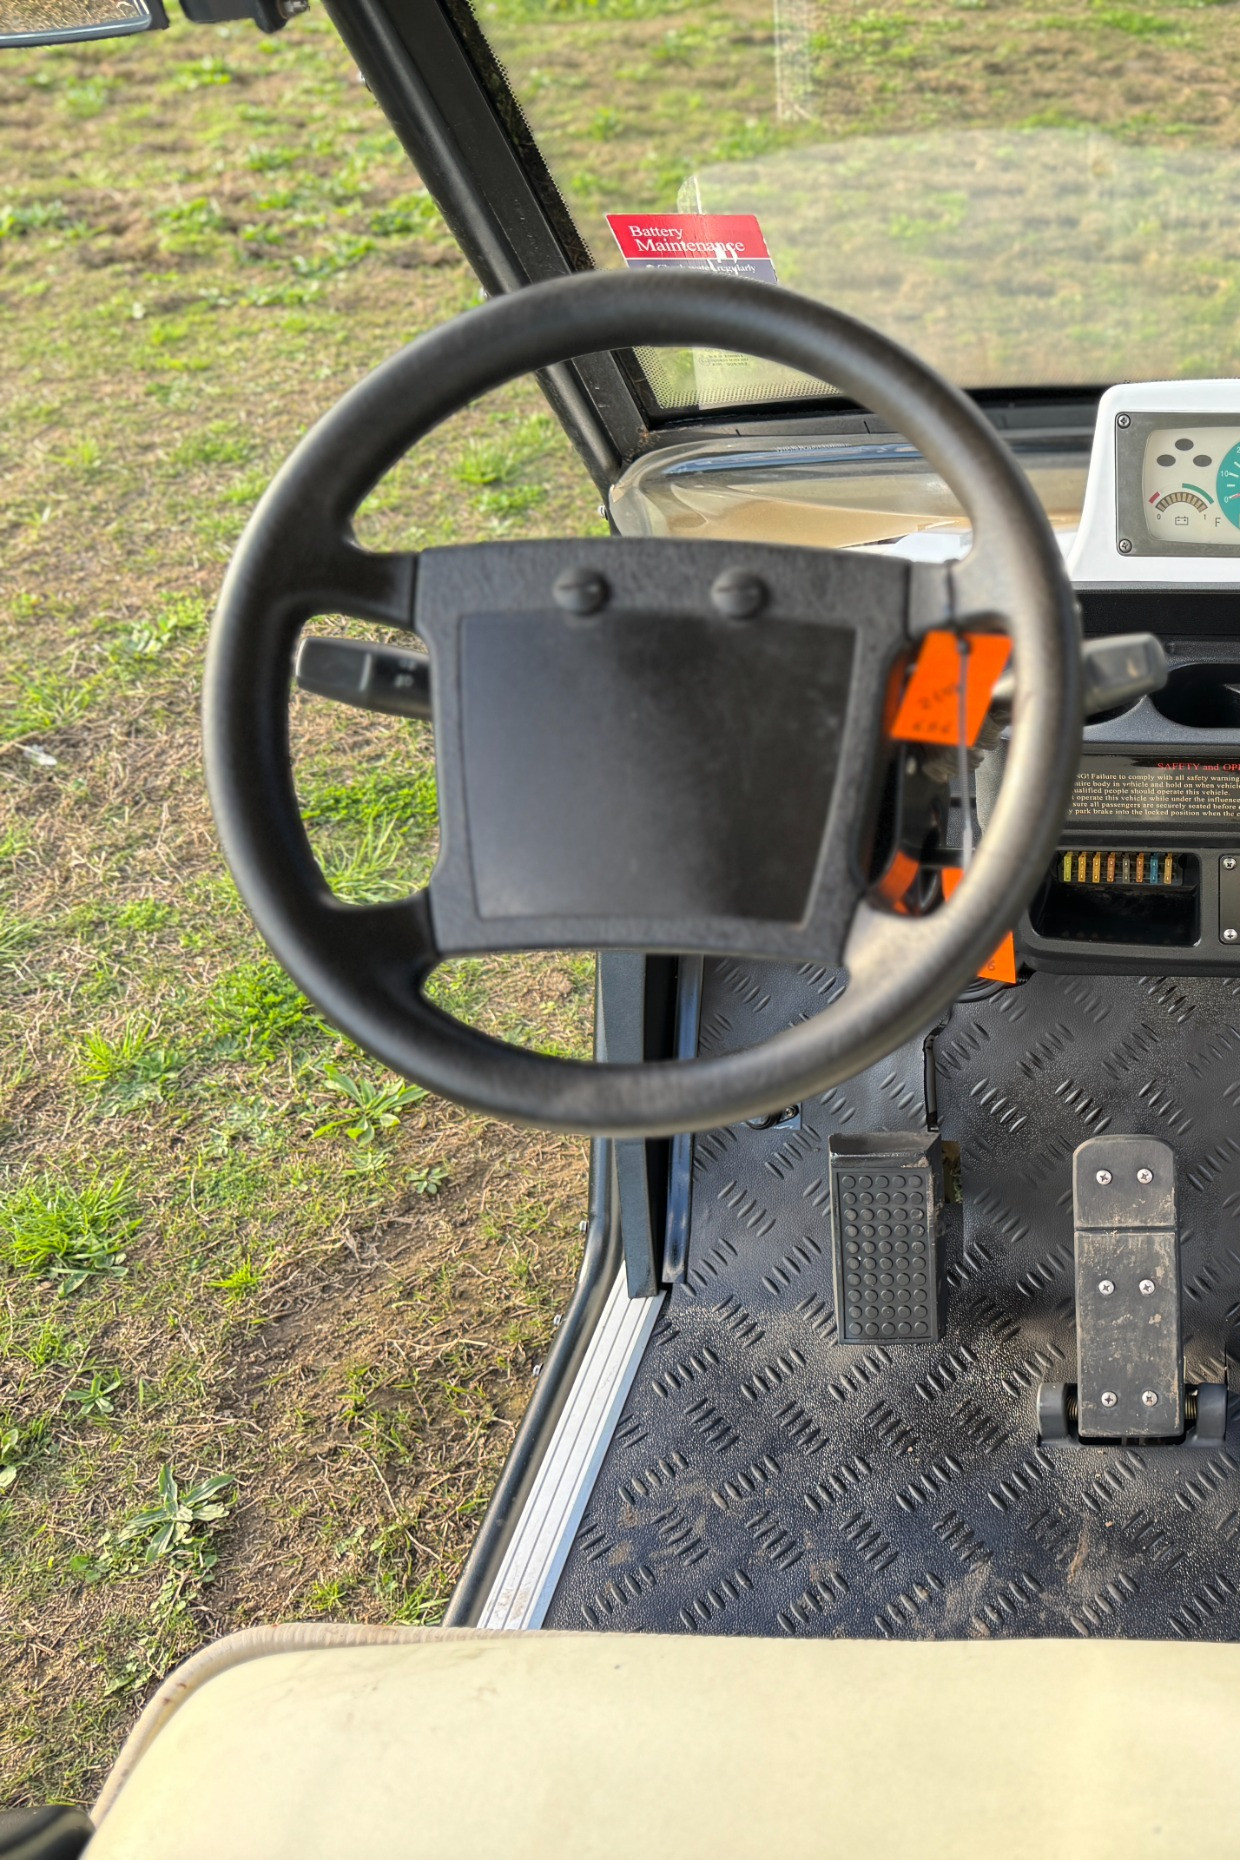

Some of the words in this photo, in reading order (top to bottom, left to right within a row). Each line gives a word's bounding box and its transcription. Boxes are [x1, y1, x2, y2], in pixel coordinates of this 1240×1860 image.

[628, 225, 683, 240] Battery
[634, 239, 745, 252] Maintenance
[1215, 517, 1221, 528] F
[1157, 762, 1200, 771] SAFETY
[1202, 763, 1219, 771] and
[1101, 802, 1141, 810] passengers
[1156, 802, 1186, 810] securely
[1170, 809, 1200, 817] position
